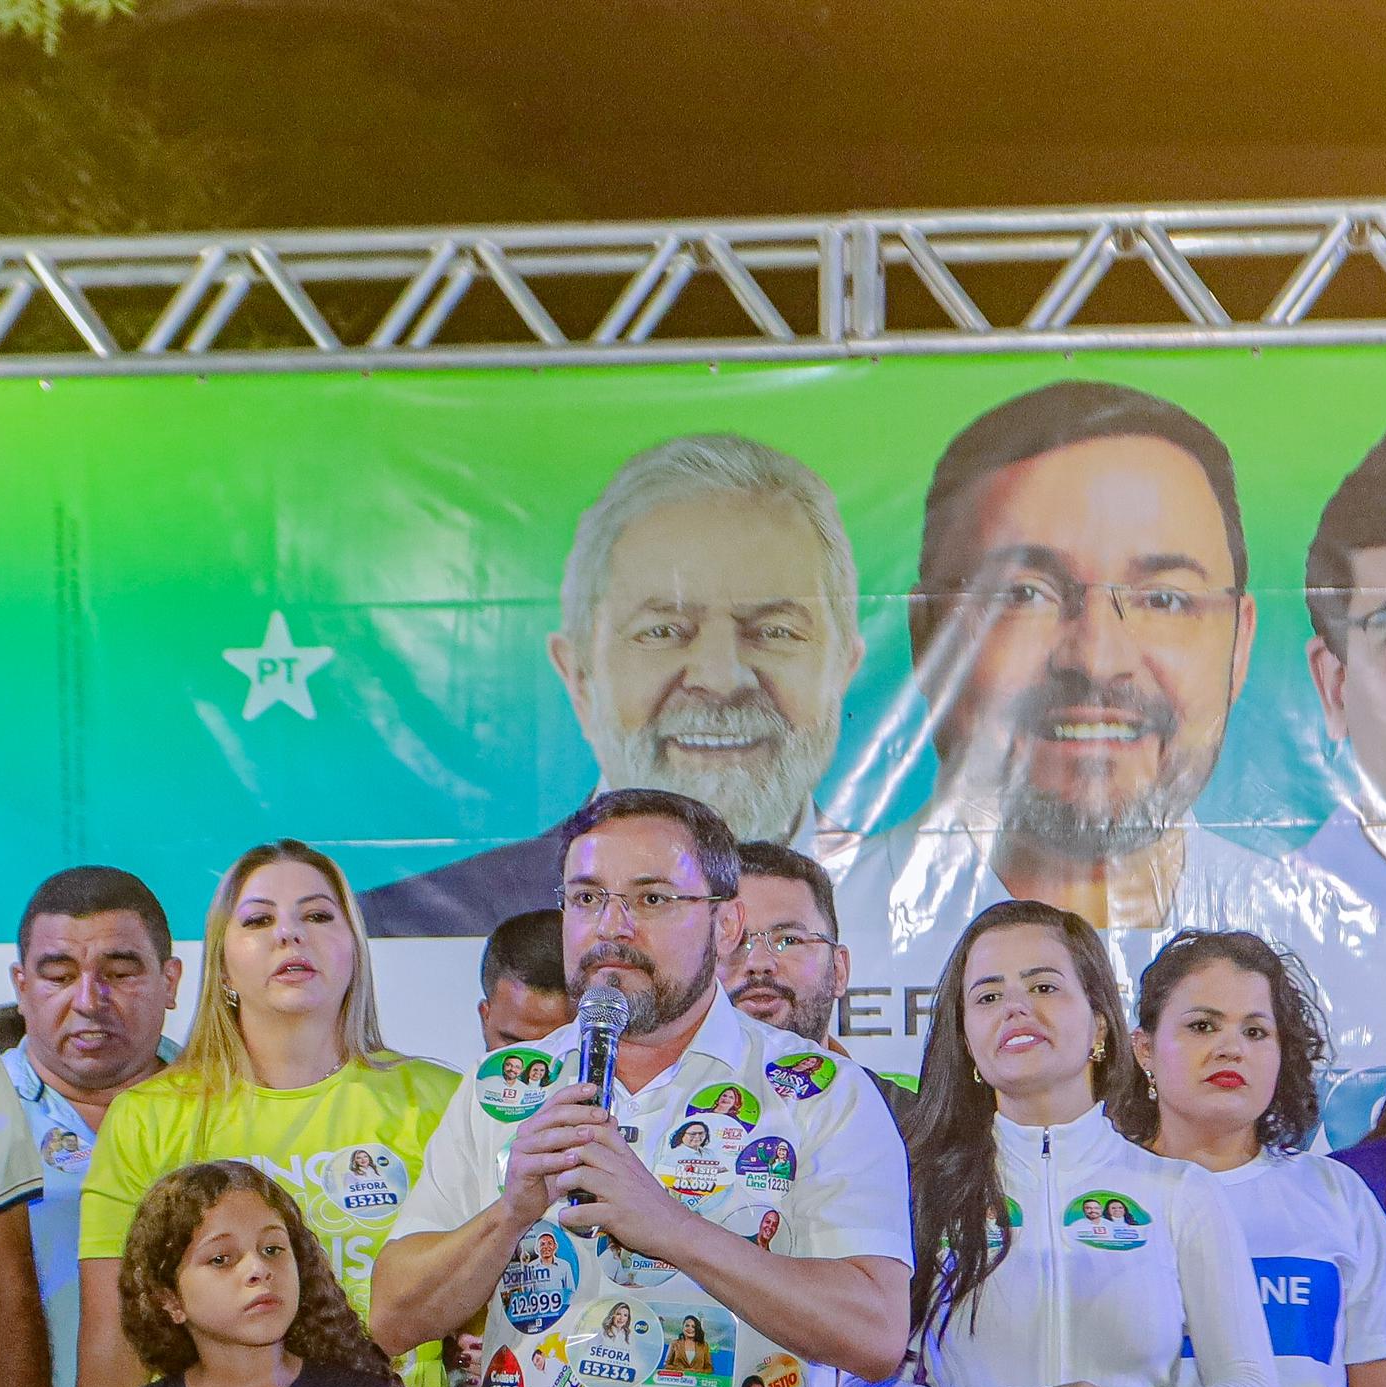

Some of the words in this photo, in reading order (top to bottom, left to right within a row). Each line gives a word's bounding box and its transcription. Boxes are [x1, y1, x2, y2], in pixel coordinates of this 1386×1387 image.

[258, 657, 299, 685] PT
[349, 1181, 388, 1193] SÉFORA
[349, 1194, 394, 1208] 55234
[512, 1292, 562, 1316] 12.999
[589, 1346, 631, 1363] SÉFORA
[582, 1361, 630, 1382] 55234
